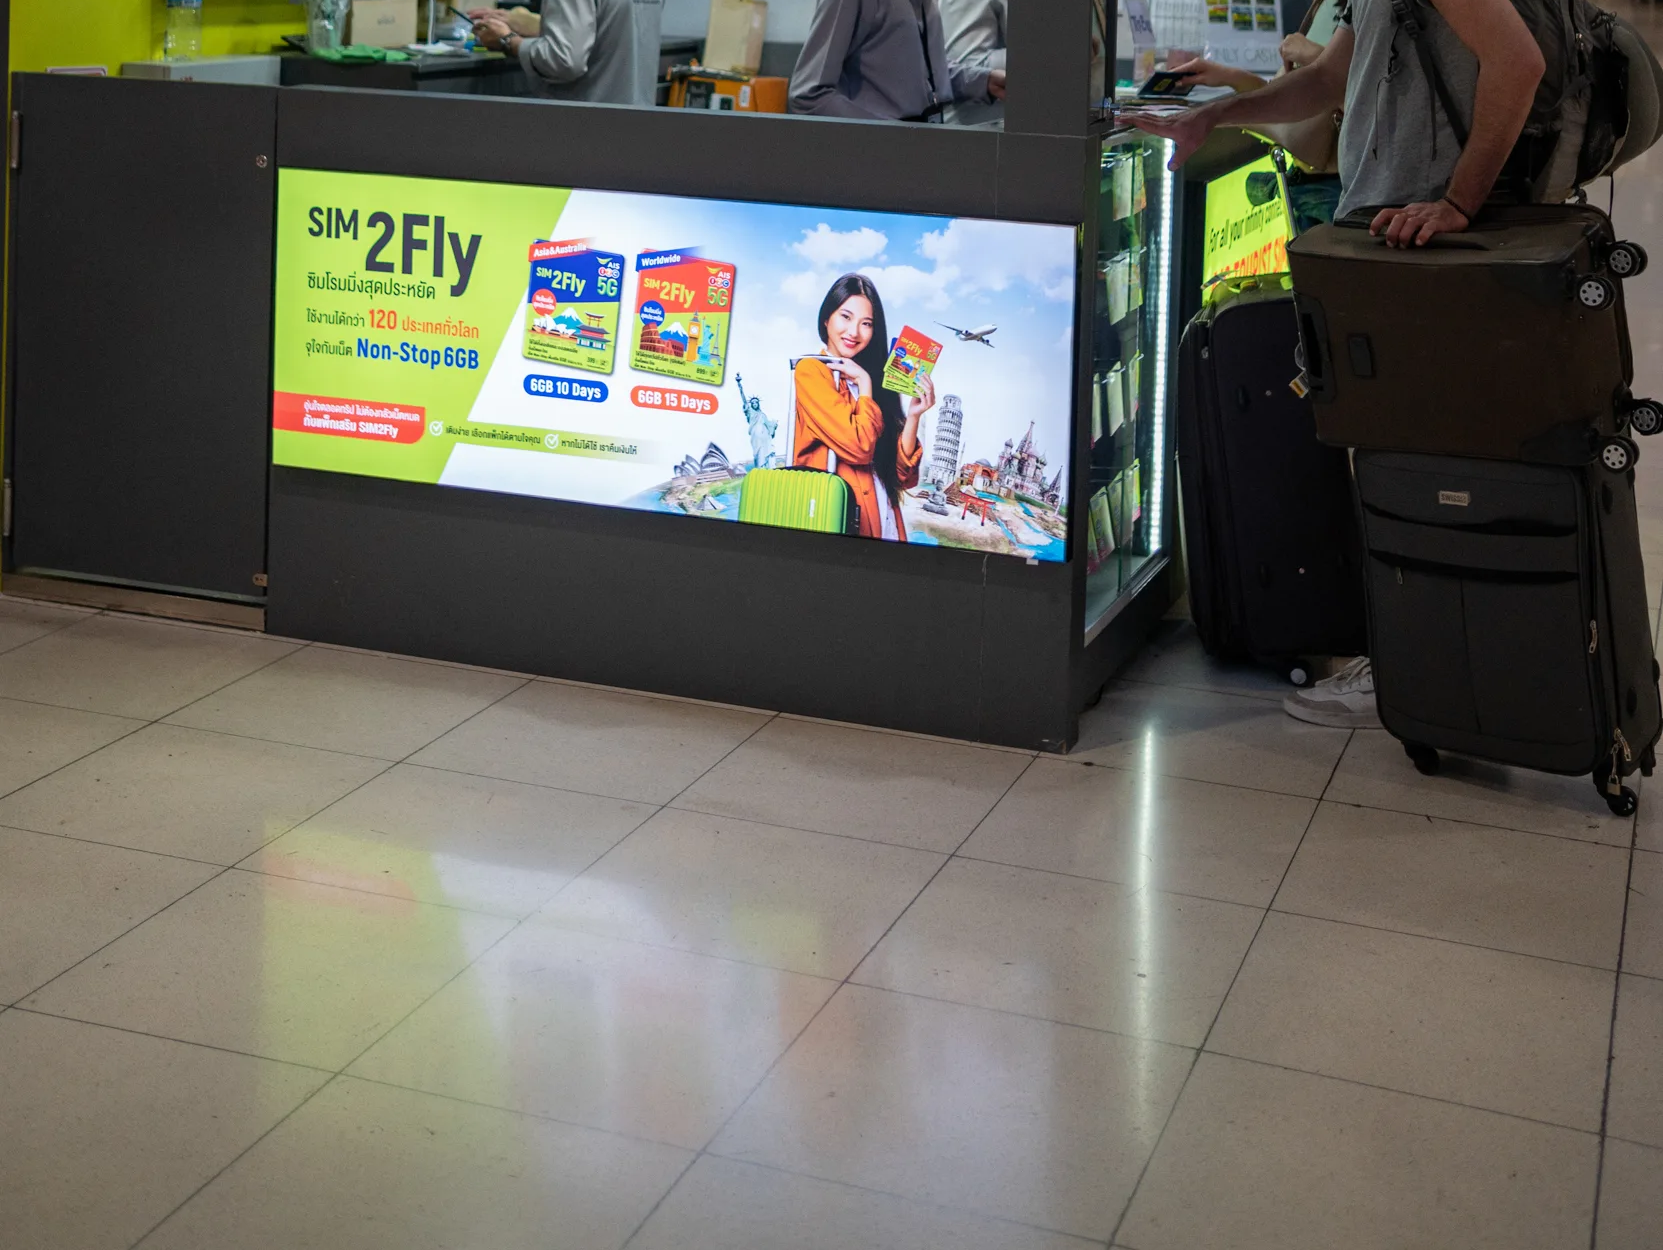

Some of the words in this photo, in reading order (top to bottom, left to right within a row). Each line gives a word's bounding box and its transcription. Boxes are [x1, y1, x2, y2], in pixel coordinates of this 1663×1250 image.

[307, 206, 359, 241] SIM
[365, 211, 483, 298] 2Fly
[533, 243, 588, 258] Asia&Australia
[641, 253, 681, 267] Worldwide
[607, 261, 620, 270] AIS
[717, 271, 731, 280] AIS
[536, 266, 552, 279] SIM
[551, 270, 587, 298] 2Fly
[597, 277, 618, 297] 5G
[643, 277, 660, 290] SIM
[659, 280, 696, 309] 2Fly
[707, 286, 729, 307] 5G
[368, 309, 398, 331] 120
[356, 337, 441, 370] Non-Stop
[443, 346, 480, 370] 6GB
[530, 377, 554, 393] 6GB
[556, 381, 570, 394] 10
[572, 383, 602, 401] Days
[637, 389, 662, 406] 6GB
[664, 392, 678, 407] 15
[680, 394, 711, 413] Days
[358, 421, 399, 439] SIM2Fly
